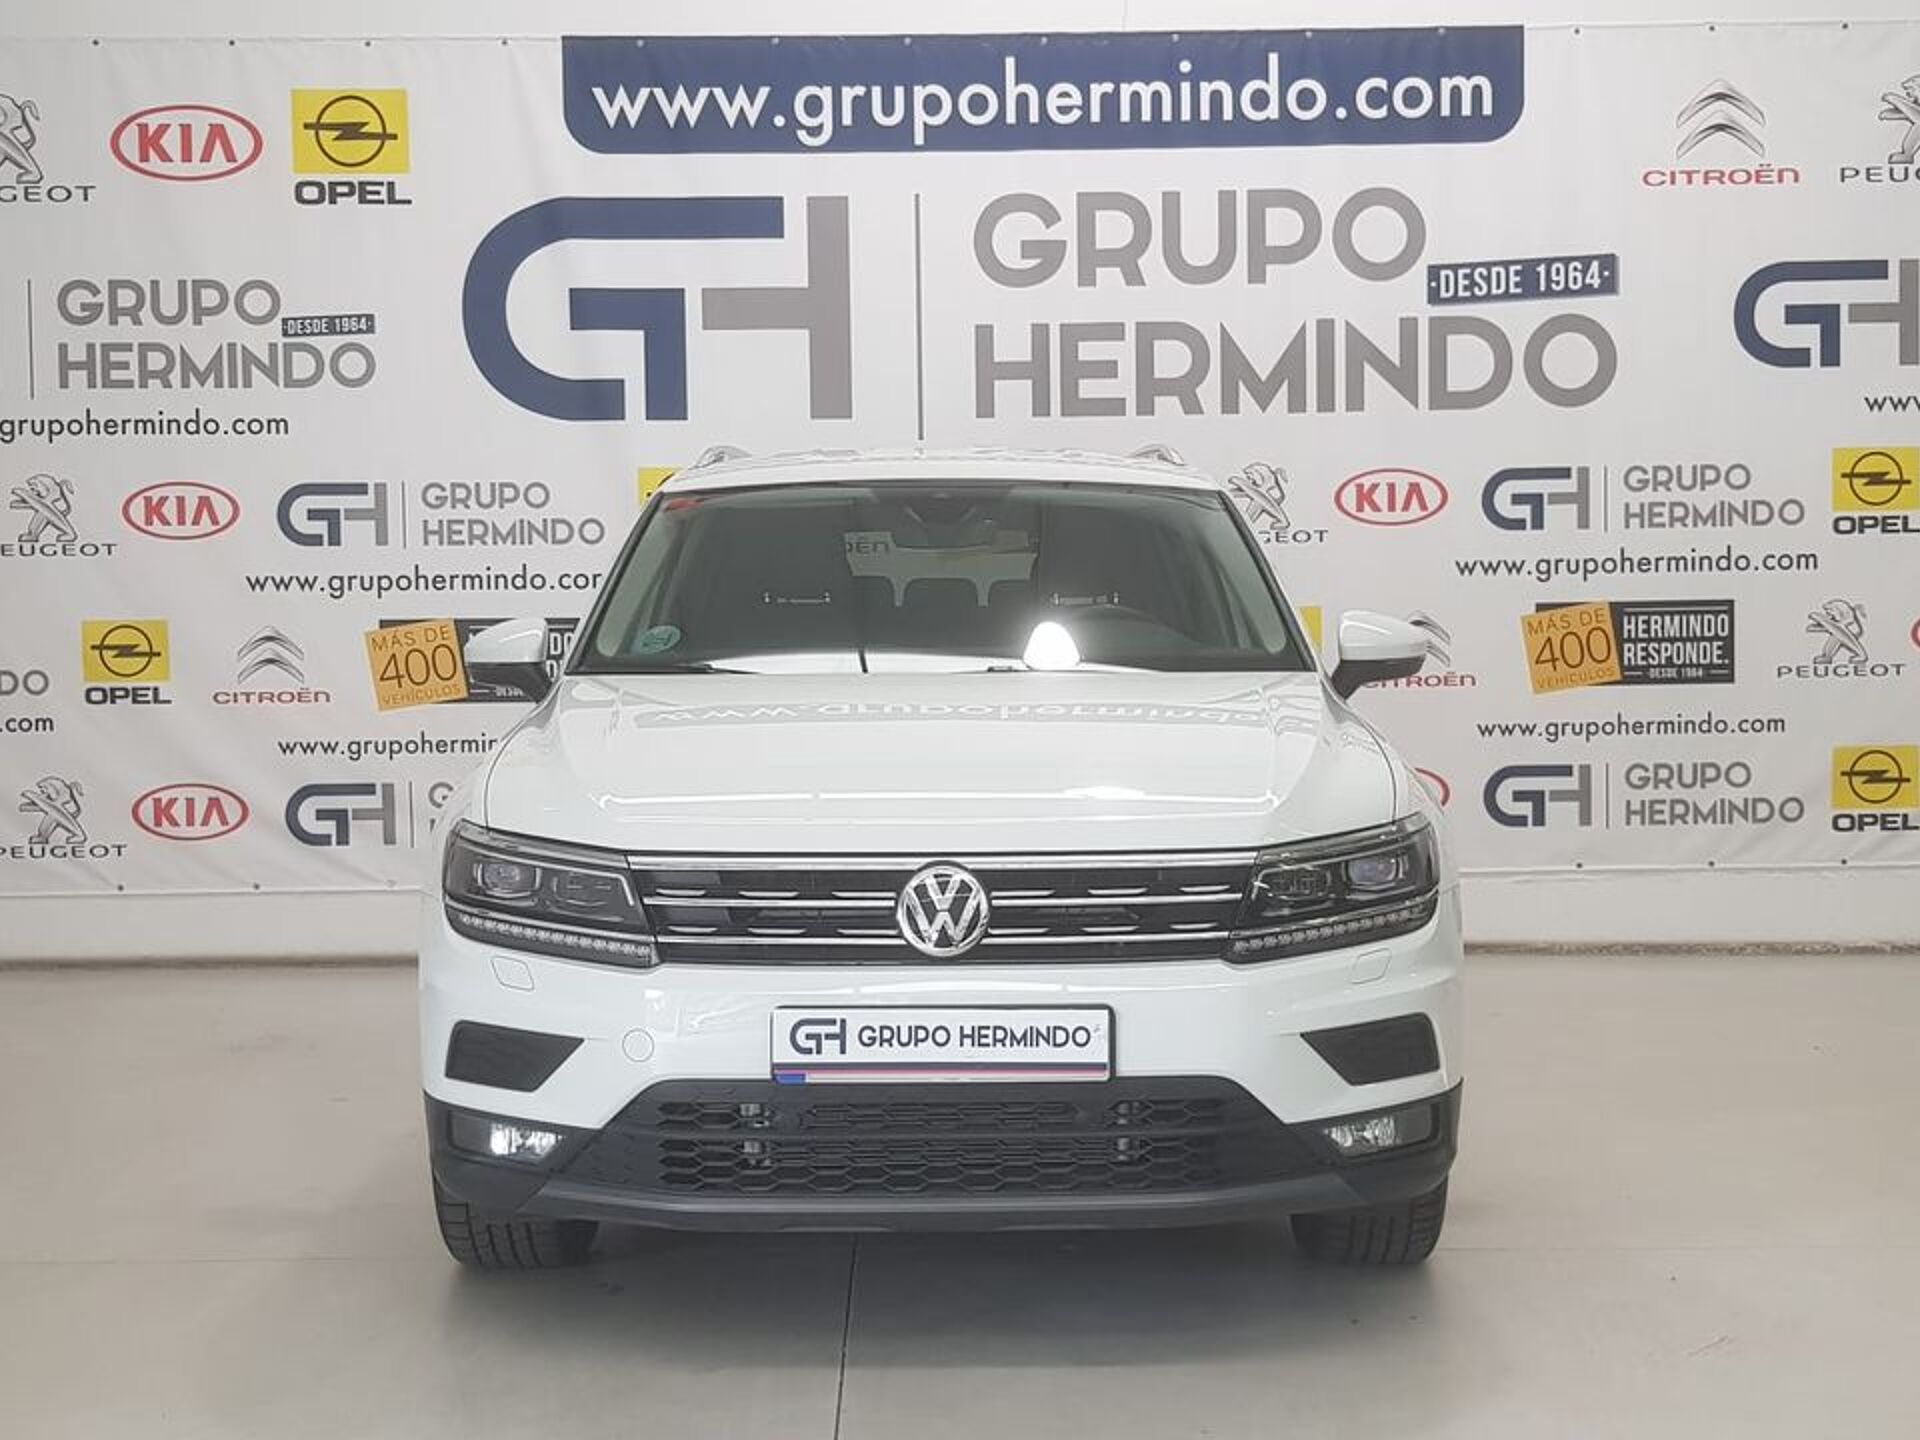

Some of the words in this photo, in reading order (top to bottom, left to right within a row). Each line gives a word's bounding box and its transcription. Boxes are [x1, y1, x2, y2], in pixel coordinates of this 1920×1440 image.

[593, 54, 1493, 145] www.grupohermindo.com
[136, 122, 238, 163] KIA
[294, 181, 412, 205] OPEL
[972, 186, 1427, 288] GRUPO
[57, 279, 281, 326] GRUPO
[58, 341, 376, 389] HERMINDO
[974, 312, 1618, 420] HERMINDO
[0, 408, 289, 443] grupohermindo.com
[1623, 464, 1751, 492] GRUPO
[421, 481, 550, 509] GRUPO
[1353, 481, 1432, 514] KIA
[143, 495, 221, 527] KIA
[1623, 499, 1805, 530] HERMINDO
[1832, 515, 1920, 535] OPEL
[422, 517, 606, 547] HERMINDO
[1455, 545, 1820, 582] www.grupohermindo.com
[1579, 607, 1606, 627] DE
[1622, 614, 1729, 639] HERMINDO
[424, 625, 450, 643] DE
[1535, 626, 1611, 671] 400
[379, 643, 457, 688] 400
[1622, 641, 1729, 667] RESPONDE.
[1776, 664, 1906, 678] PEUGEOT
[85, 687, 173, 705] OPEL
[1477, 712, 1786, 742] www.grupohermindo.com
[1624, 762, 1751, 790] GRUPO
[152, 797, 230, 828] KIA
[1624, 797, 1805, 828] HERMINDO
[1831, 813, 1920, 832] OPEL
[858, 1025, 951, 1048] GRUPO
[959, 1025, 1091, 1048] HERMINDO
